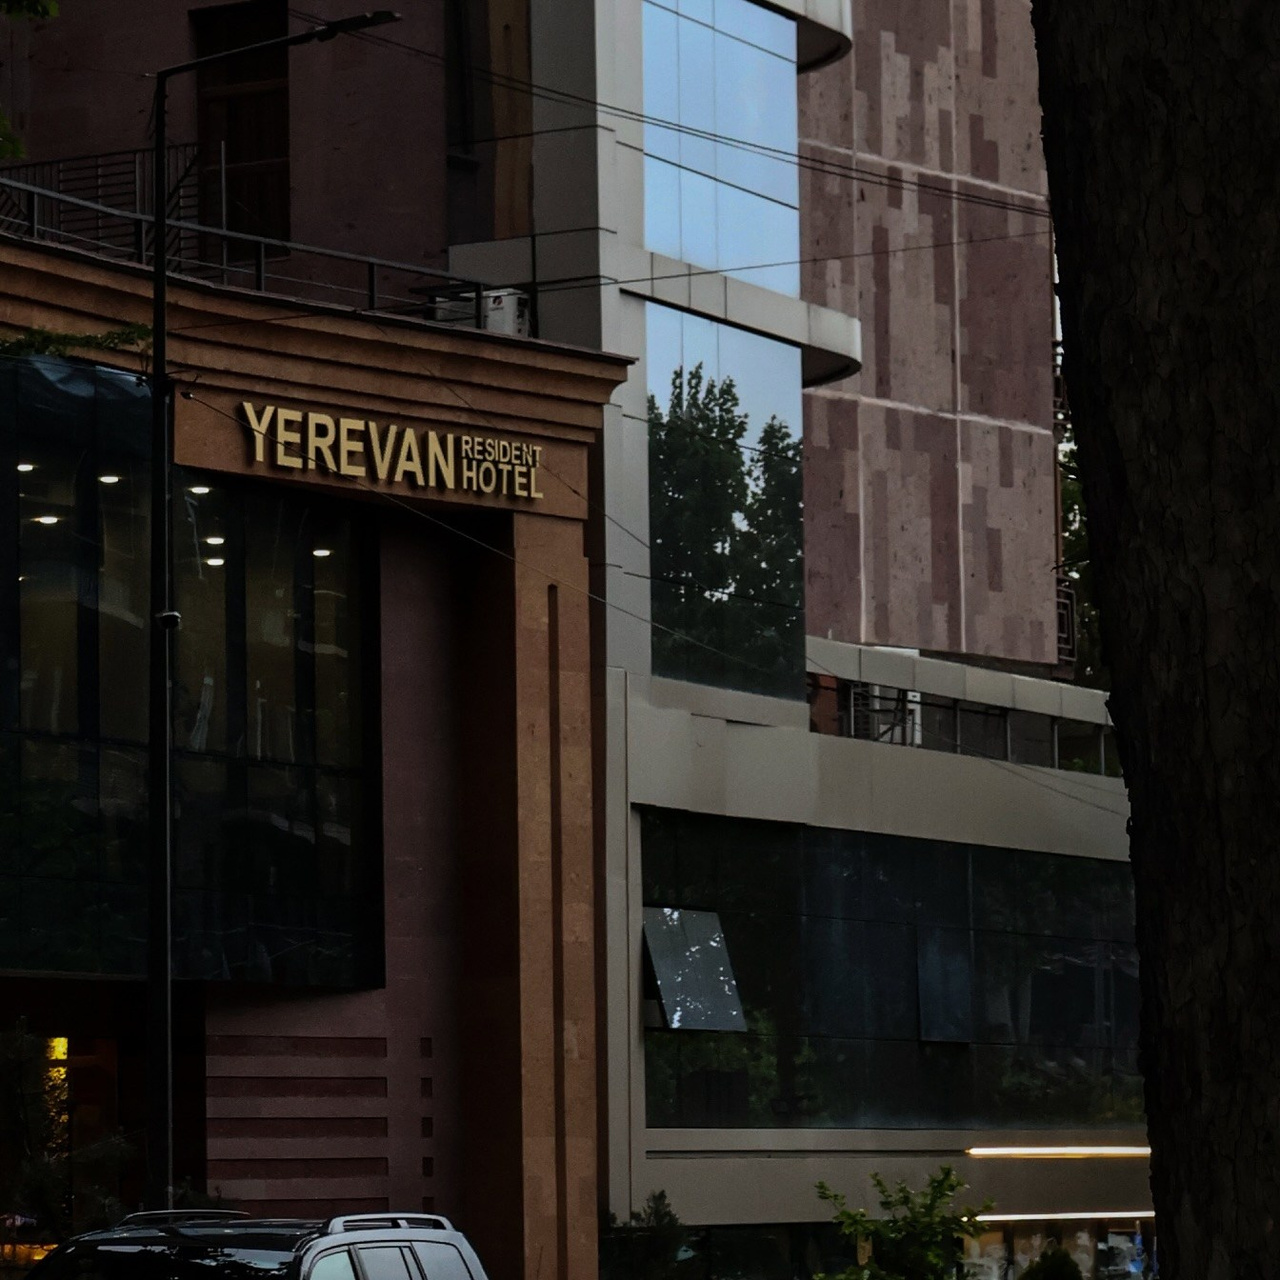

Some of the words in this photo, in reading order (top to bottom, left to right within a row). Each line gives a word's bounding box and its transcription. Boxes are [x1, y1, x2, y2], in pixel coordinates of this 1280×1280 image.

[241, 400, 455, 490] YEREVAN
[460, 435, 543, 468] RESIDENT
[461, 458, 544, 499] HOTEL
